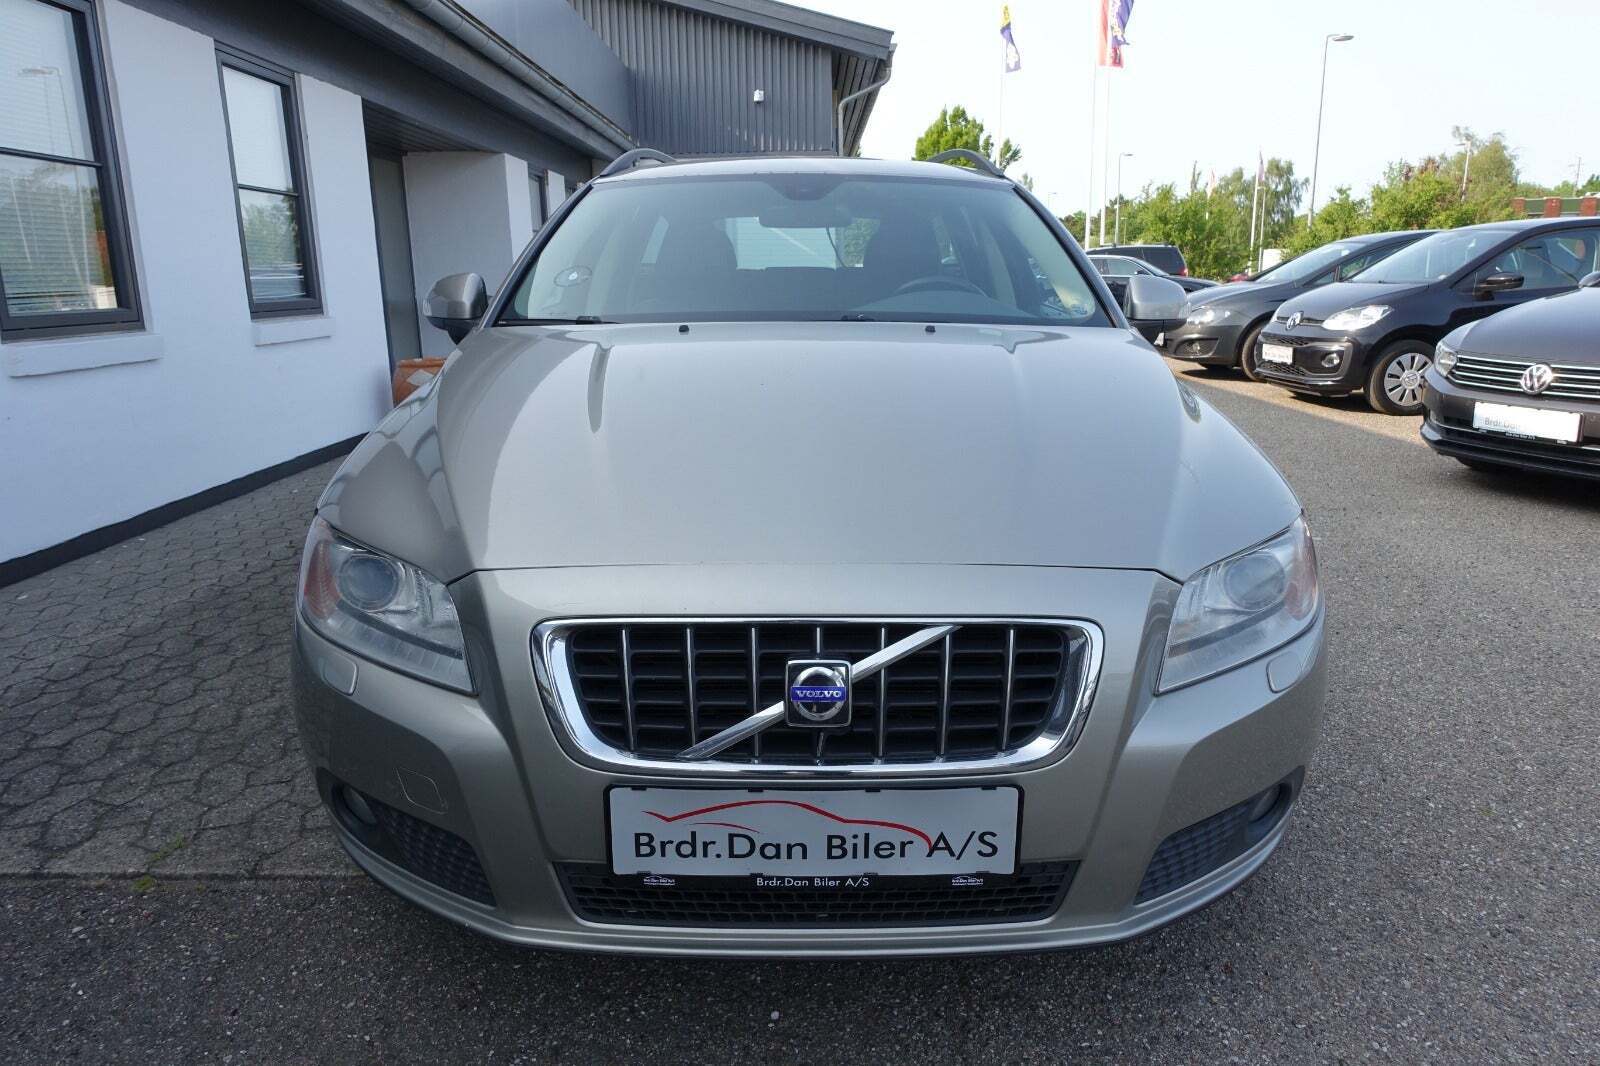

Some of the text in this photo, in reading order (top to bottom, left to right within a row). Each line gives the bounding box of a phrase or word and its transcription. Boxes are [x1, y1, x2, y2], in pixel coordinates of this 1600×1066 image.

[796, 690, 842, 698] VOLVO
[633, 830, 999, 860] Brdr.Dan Biler A/S
[756, 877, 870, 888] Brdr.Dan Biler A/S
